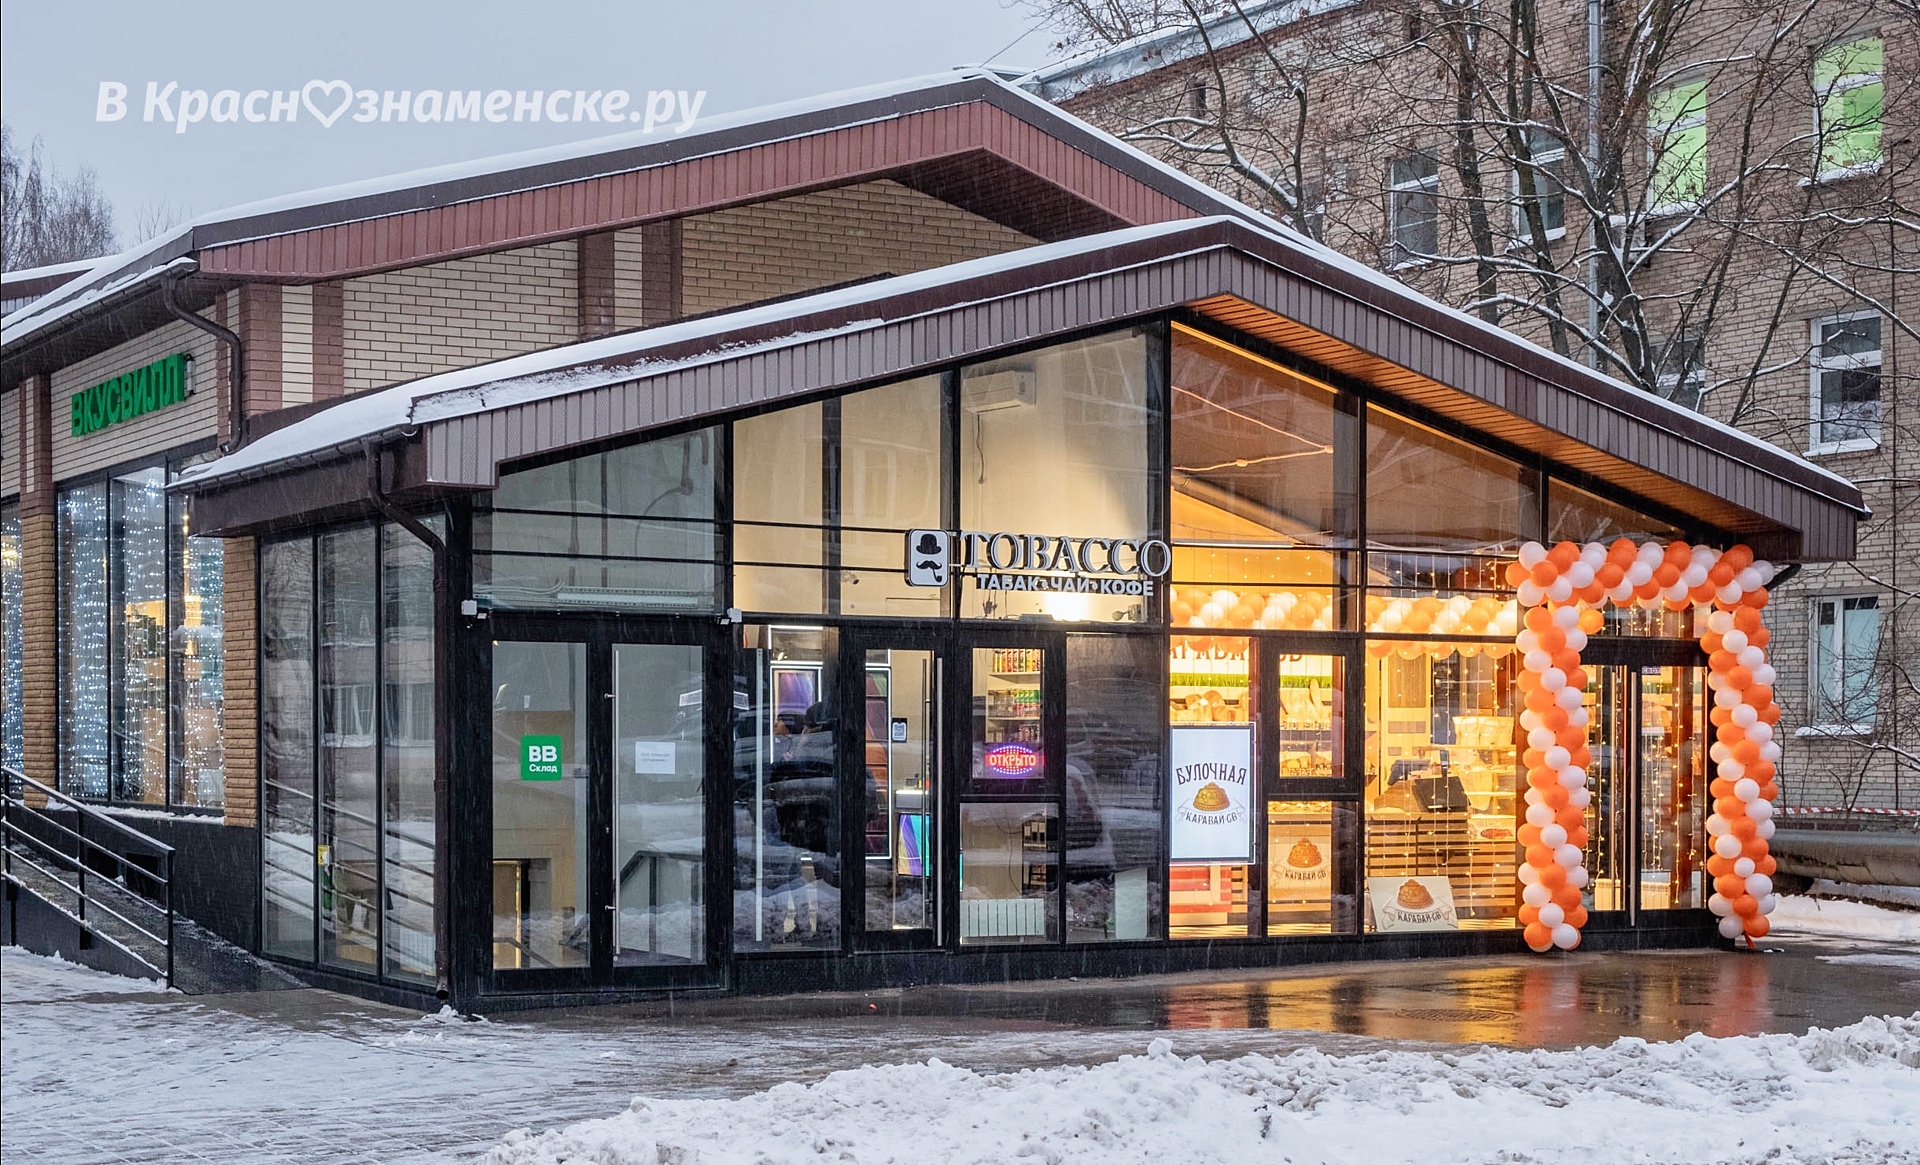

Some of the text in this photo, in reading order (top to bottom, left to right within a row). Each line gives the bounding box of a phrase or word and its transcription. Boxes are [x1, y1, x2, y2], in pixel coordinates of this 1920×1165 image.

[71, 353, 184, 437] ВКУСВИЛЛ
[960, 532, 1172, 577] TOBACCO
[977, 574, 1154, 596] ТАБАК ЧАЙ КОФЕ
[528, 746, 558, 762] ВВ
[989, 754, 1036, 766] ОТКРЫТО
[529, 764, 558, 773] Склад
[1175, 762, 1247, 785] БУЛОЧНАЯ
